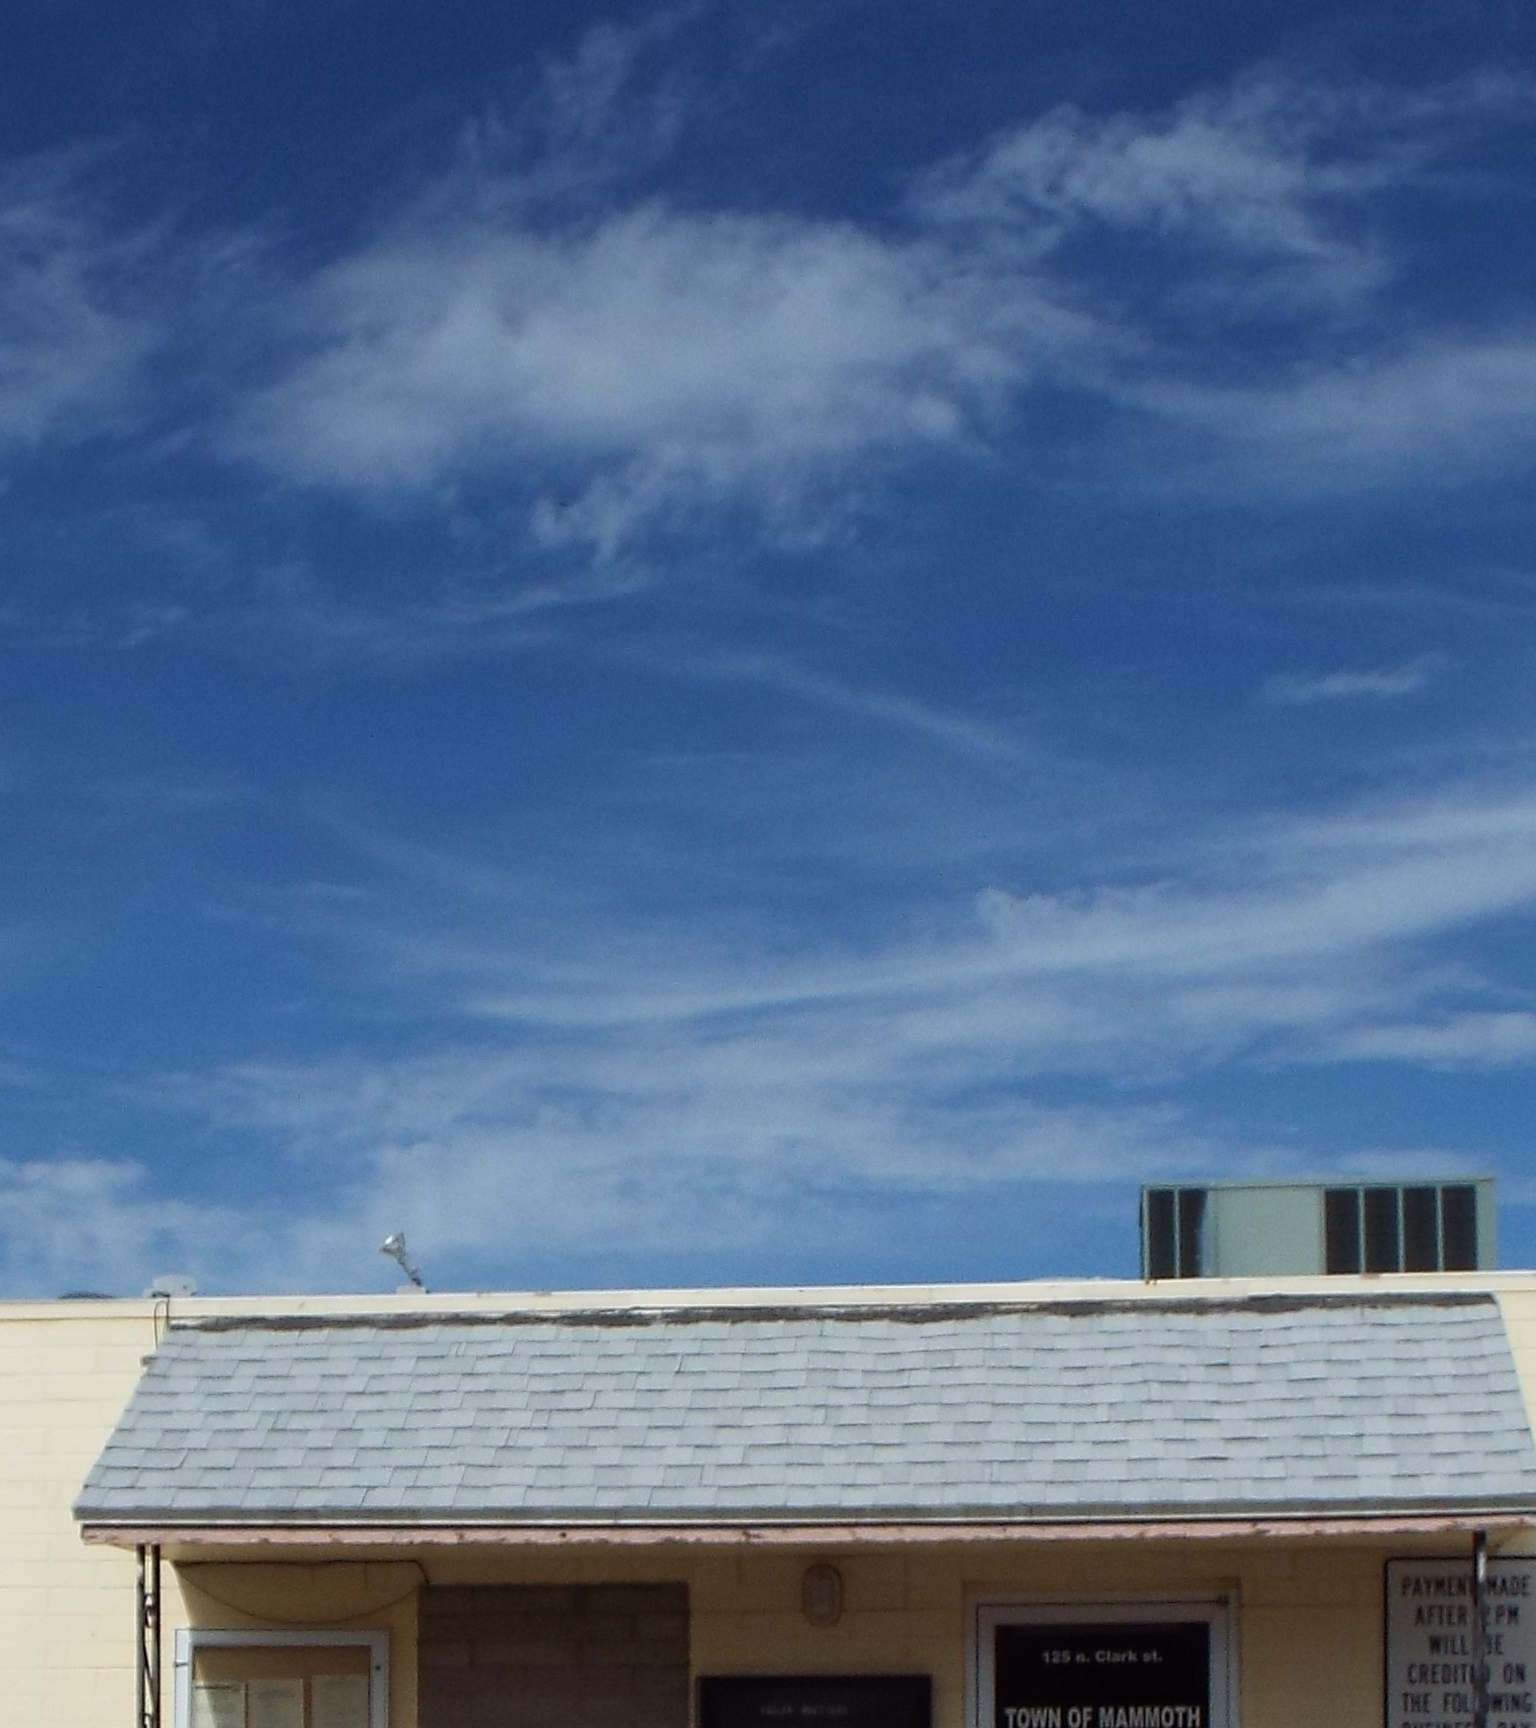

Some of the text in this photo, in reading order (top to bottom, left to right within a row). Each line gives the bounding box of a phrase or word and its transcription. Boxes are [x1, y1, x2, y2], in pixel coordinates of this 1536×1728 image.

[1401, 1575, 1531, 1597] PAYMEN MADE
[1414, 1605, 1468, 1627] AFTER
[1095, 1649, 1138, 1663] Clark
[1429, 1635, 1470, 1656] WILL
[1503, 1663, 1527, 1684] ON
[1402, 1693, 1533, 1714] THE FOLWING
[1068, 1706, 1093, 1728] OF
[1099, 1706, 1201, 1728] MAMMOTH
